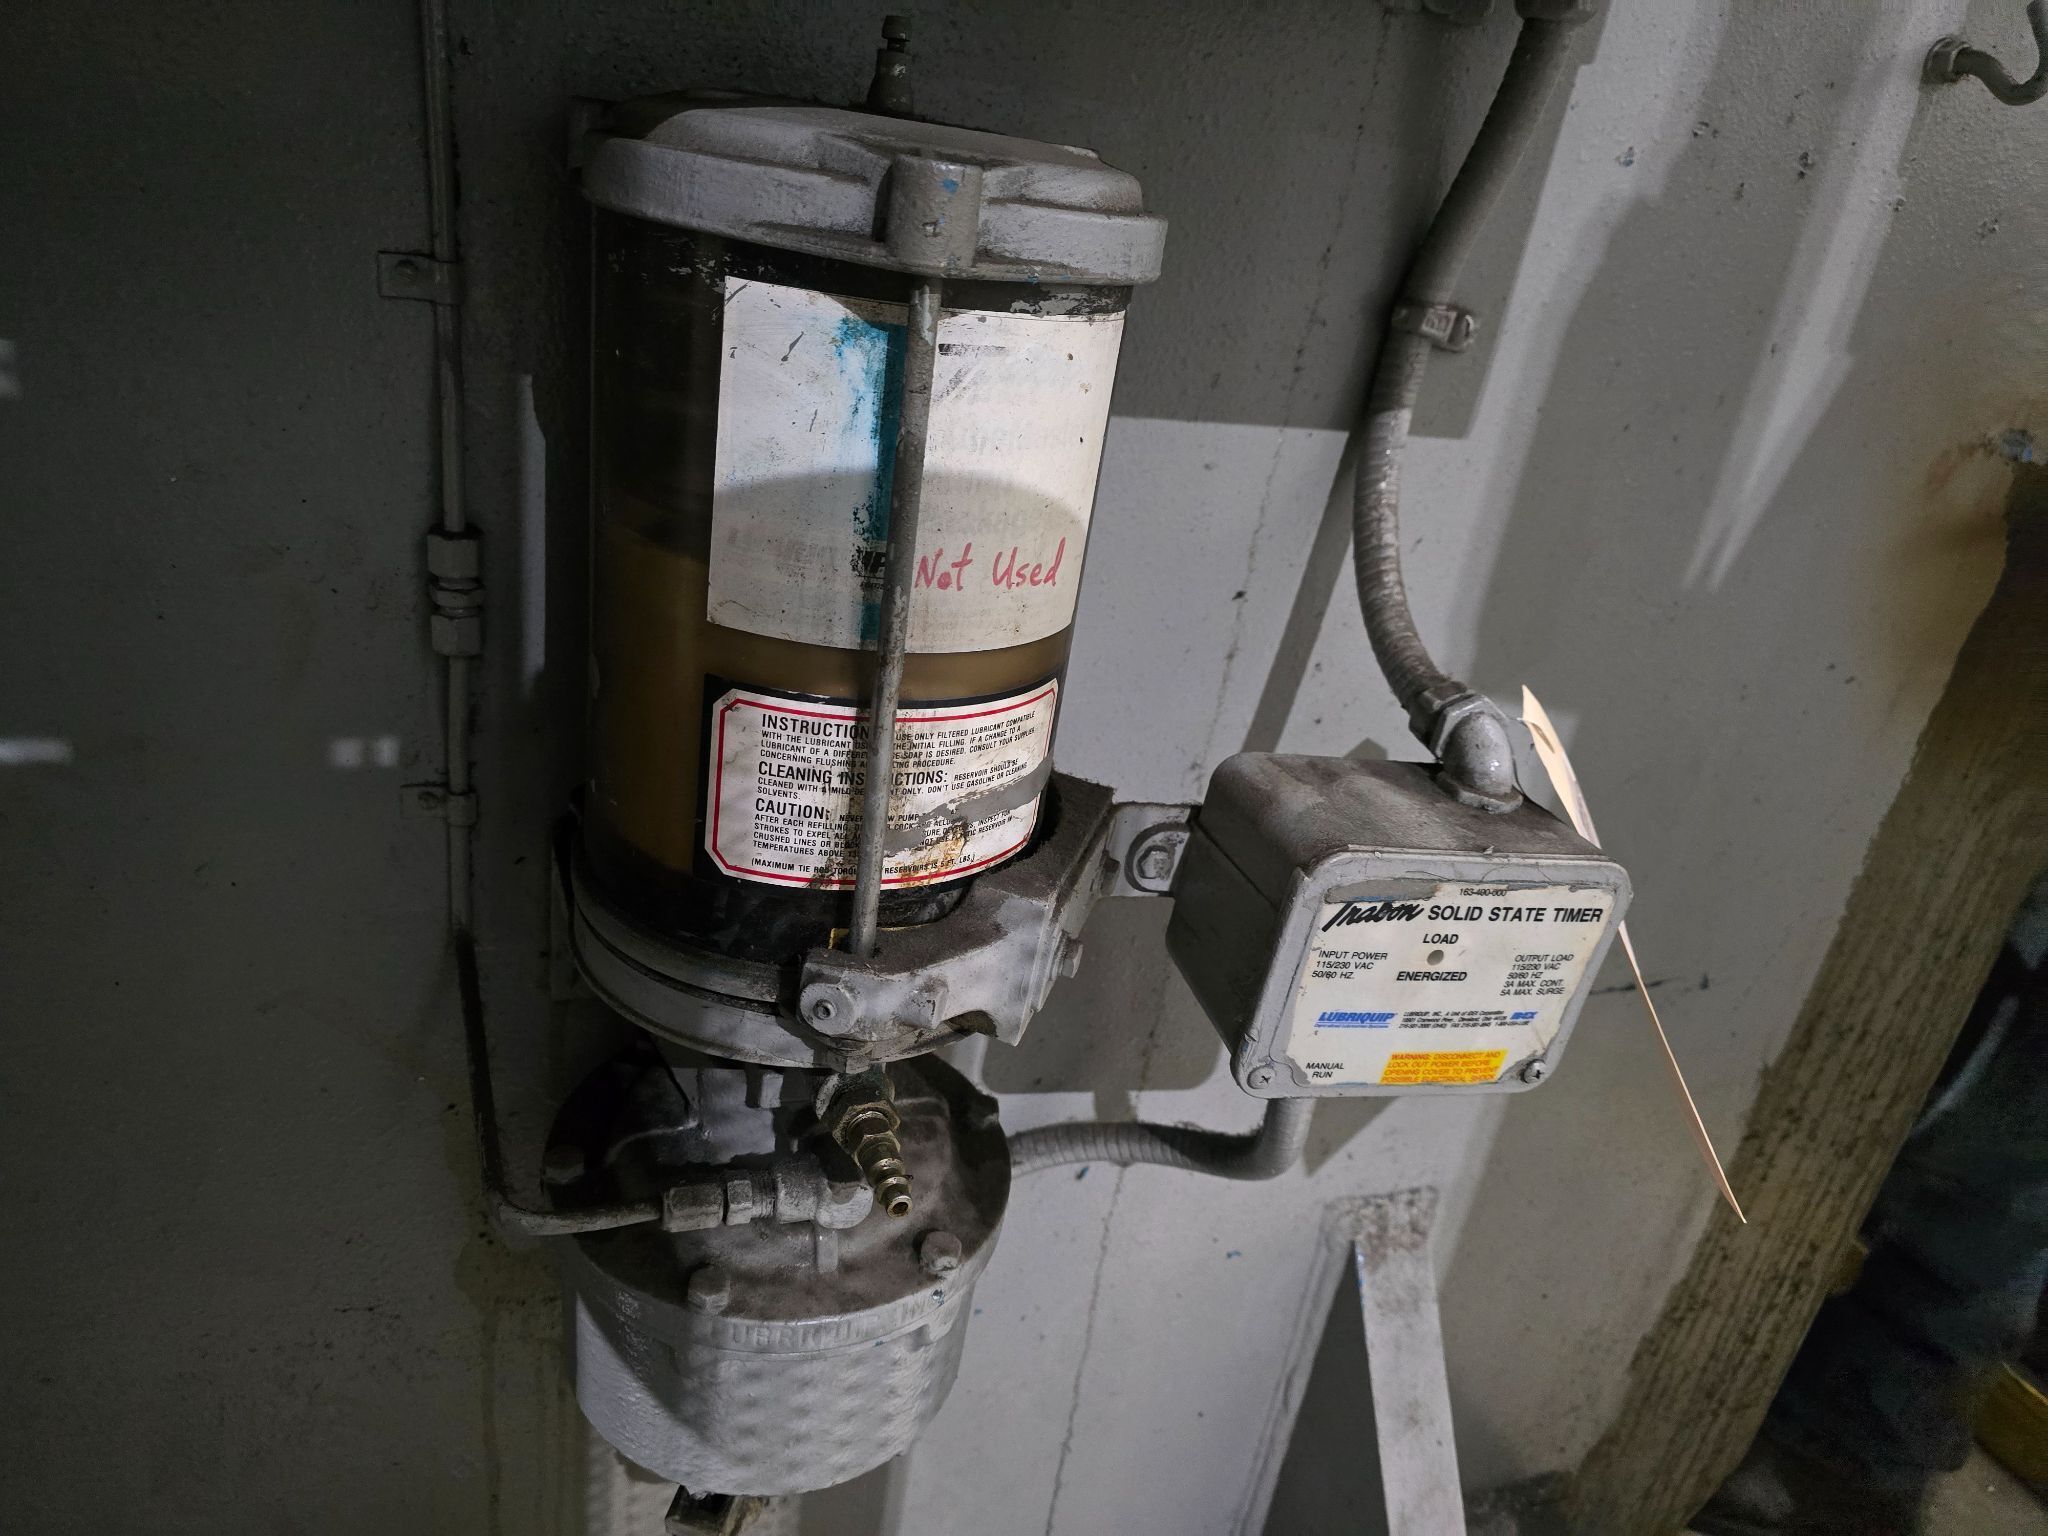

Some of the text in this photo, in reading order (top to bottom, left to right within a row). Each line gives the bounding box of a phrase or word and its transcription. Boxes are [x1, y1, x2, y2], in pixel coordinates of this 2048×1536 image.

[915, 542, 972, 591] Not
[992, 537, 1066, 590] Used
[762, 711, 1036, 741] INSTRUCTION USE ONLY FILTERED LUBRICANT COMPATIBLE
[761, 730, 782, 741] WITH
[786, 734, 802, 744] THE
[805, 737, 852, 749] LUBRICANT
[910, 741, 935, 750] INITIAL
[978, 735, 982, 743] A
[985, 729, 1007, 742] CHANGE
[1010, 726, 1016, 734] TO
[761, 740, 806, 755] LUBRICANT
[810, 747, 820, 756] OF
[904, 751, 923, 760] SOAP
[926, 751, 933, 759] IS
[969, 741, 997, 753] CONSULT
[999, 736, 1013, 747] YOUR
[760, 749, 812, 764] CONCERNING
[816, 758, 857, 769] FLUSHING
[912, 757, 955, 768] PROCEDURE.
[757, 776, 794, 789] CLEANED
[797, 783, 818, 793] WITH
[831, 786, 851, 795] MILD
[902, 788, 924, 796] ONLY.
[928, 784, 949, 794] DON'T
[951, 781, 965, 791] USE
[967, 774, 995, 788] GASOLINE
[997, 772, 1004, 780] OR
[1005, 762, 1028, 777] CLEANING
[758, 761, 832, 783] CLEANING
[954, 768, 988, 781] RESERVOIR
[757, 785, 801, 800] SOLVENTS.
[755, 797, 829, 820] CAUTION:
[754, 813, 779, 824] AFTER
[782, 818, 804, 828] EACH
[753, 832, 790, 844] CRUSHED
[794, 838, 817, 847] LINES
[820, 840, 831, 848] OR
[978, 819, 1006, 833] RESERVOIR
[754, 823, 789, 835] STROKES
[793, 828, 803, 837] TO
[806, 829, 831, 839] EXPEL
[753, 840, 815, 856] TEMPERATURES
[818, 849, 845, 858] ABOVE
[751, 857, 795, 871] (MAXIMUM
[798, 864, 810, 873] TIE
[884, 863, 928, 874] RESERVOIRS
[930, 862, 938, 870] IS
[1427, 904, 1483, 922] SOLID
[1488, 906, 1547, 922] STATE
[1553, 907, 1604, 923] TIMER
[1422, 933, 1459, 945] LOAD
[1318, 950, 1389, 961] INPUT POWER
[1514, 953, 1575, 963] OUTPUT LOAD
[1316, 960, 1375, 970] 115/230 VAC
[1544, 962, 1562, 971] VAC
[1311, 970, 1337, 980] 50/60
[1396, 971, 1468, 982] ENERGIZED
[1536, 986, 1566, 996] SURGE
[1318, 1011, 1396, 1025] LUBRIQUIP
[1433, 1051, 1486, 1060] DISCONNECT
[1486, 1050, 1500, 1058] AND
[1305, 1061, 1345, 1079] MANUAL RUN
[1386, 1059, 1491, 1069] LOCK OUT POWER BEFORE
[1452, 1067, 1464, 1075] TO
[1464, 1066, 1498, 1074] PREVENT
